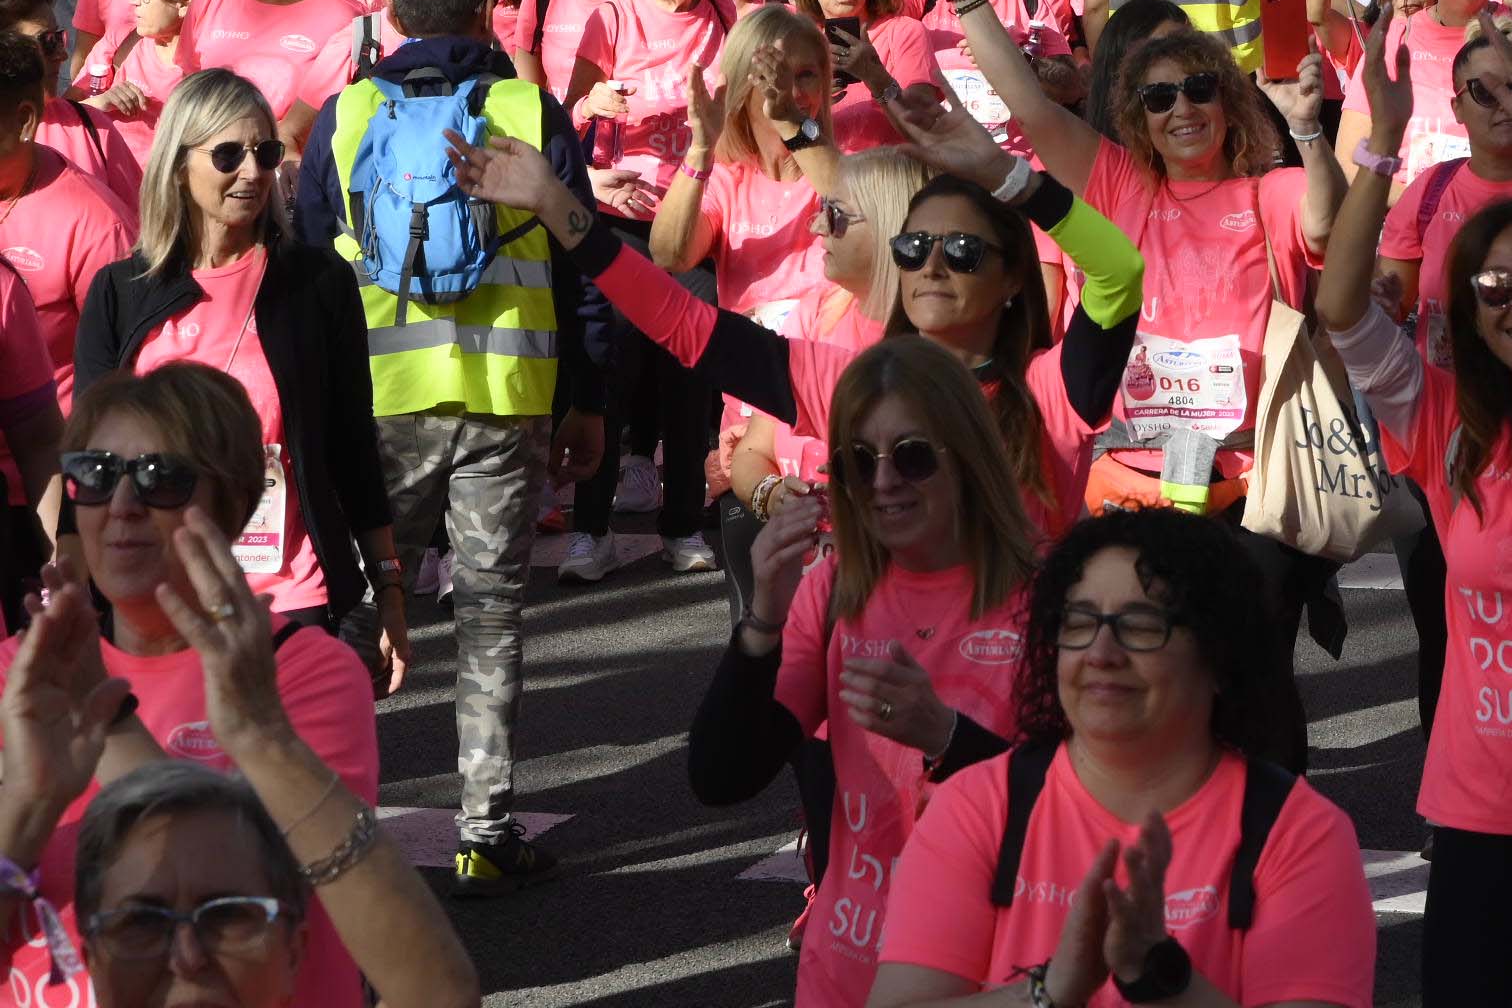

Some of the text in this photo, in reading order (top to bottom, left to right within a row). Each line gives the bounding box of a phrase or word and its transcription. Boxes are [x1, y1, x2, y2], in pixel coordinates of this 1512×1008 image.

[650, 132, 693, 157] SU
[1160, 377, 1200, 392] 016
[1168, 396, 1194, 406] 4804
[1134, 407, 1168, 416] CARRERA
[1170, 408, 1179, 416] DE
[1133, 422, 1171, 432] OYSHO
[247, 535, 269, 544] 2023
[235, 552, 271, 563] ntander
[1458, 586, 1504, 625] TU
[829, 896, 886, 953] SU
